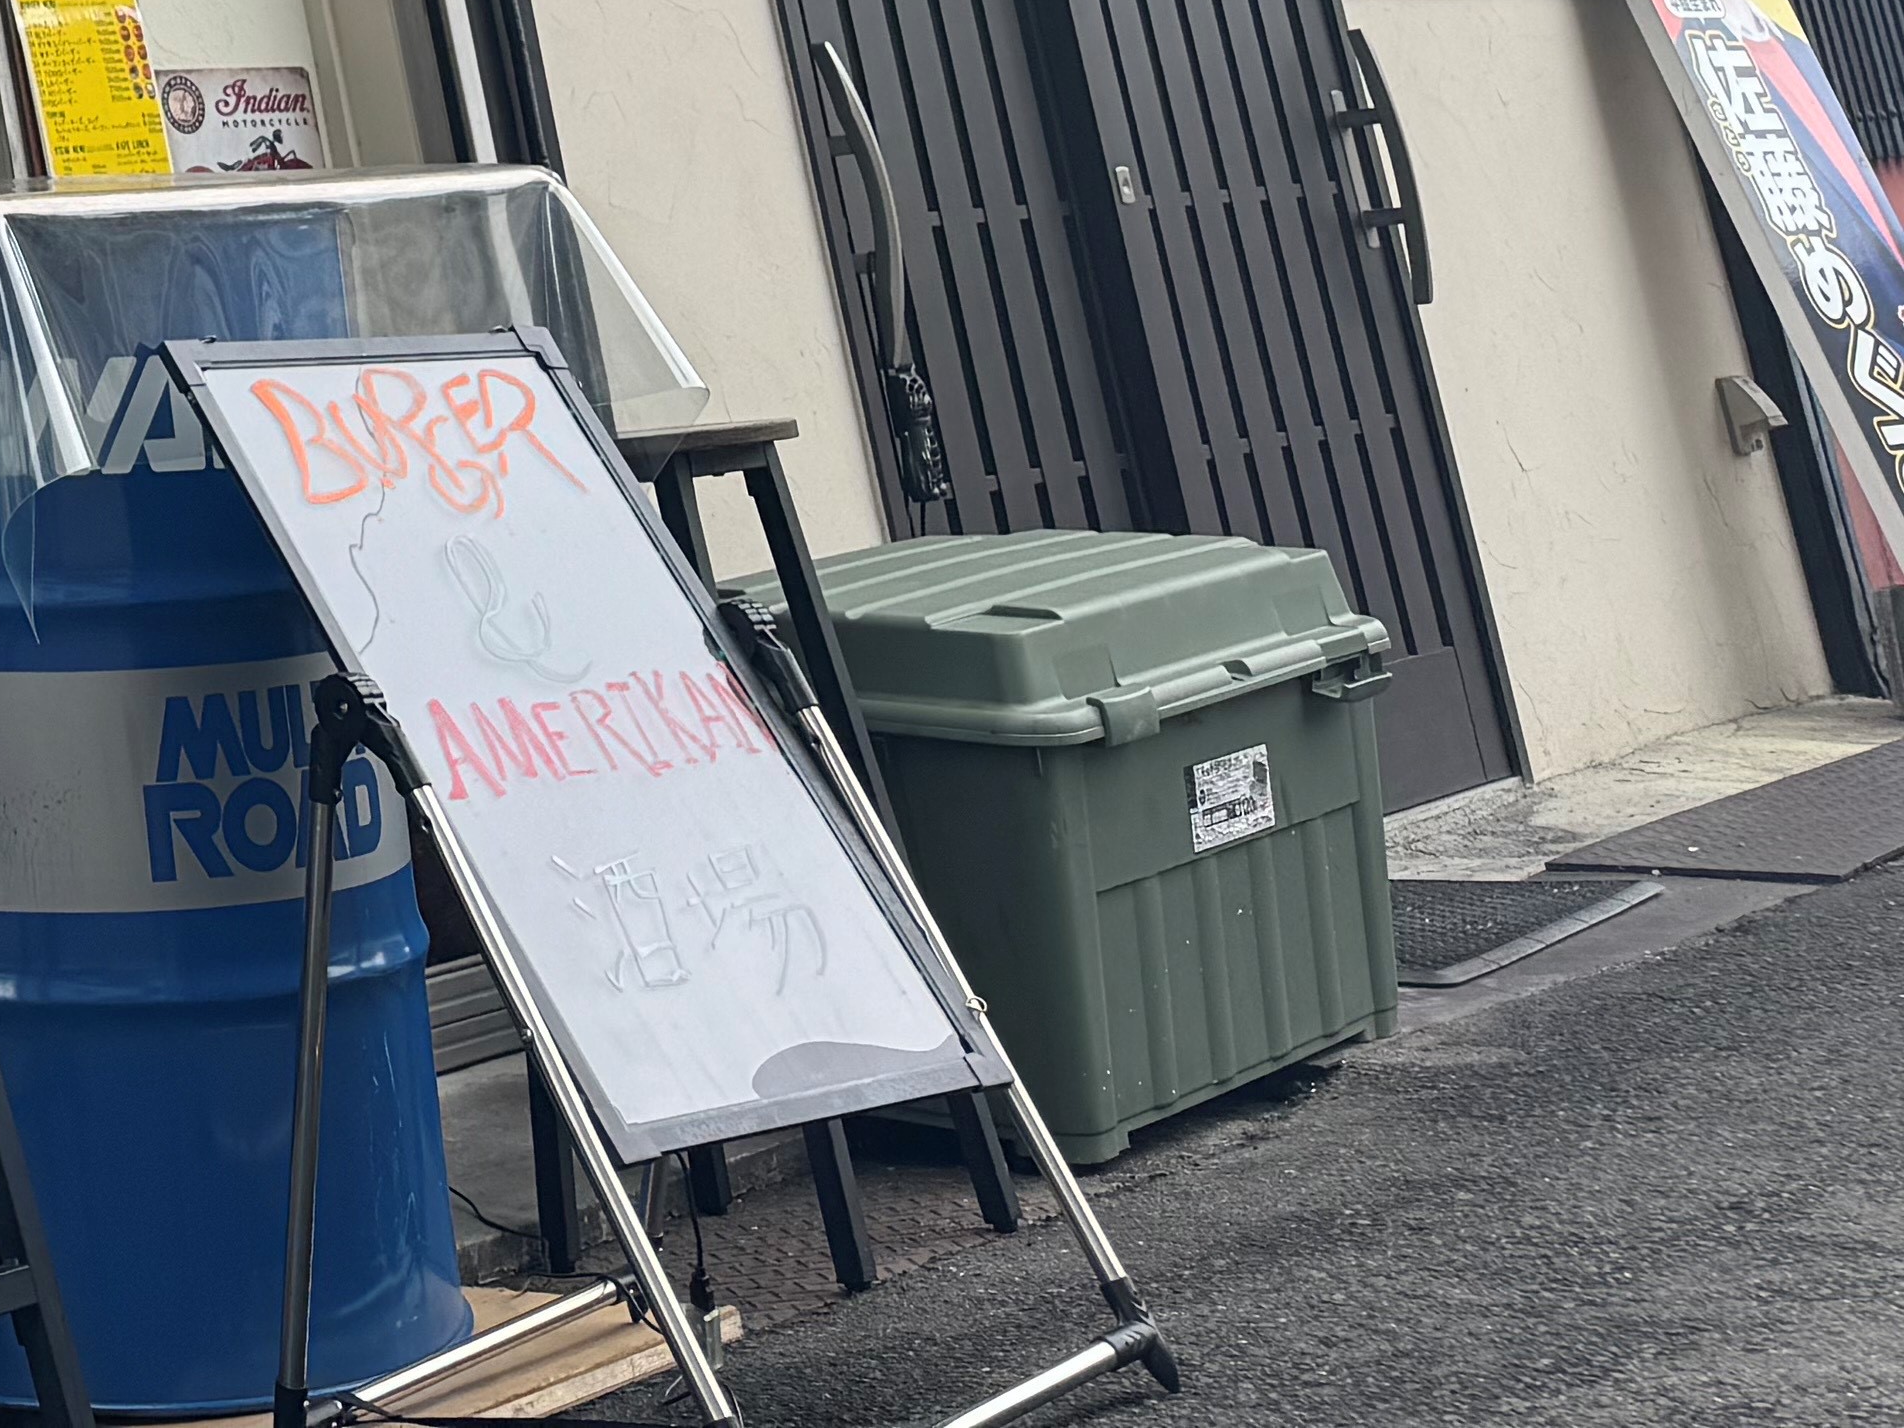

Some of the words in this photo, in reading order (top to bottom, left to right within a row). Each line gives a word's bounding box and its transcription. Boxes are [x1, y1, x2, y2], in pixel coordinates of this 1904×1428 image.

[215, 78, 310, 117] Indian
[221, 117, 309, 129] MOTORCYCLE
[250, 366, 589, 519] BURGER
[427, 660, 780, 802] AMERIKAN
